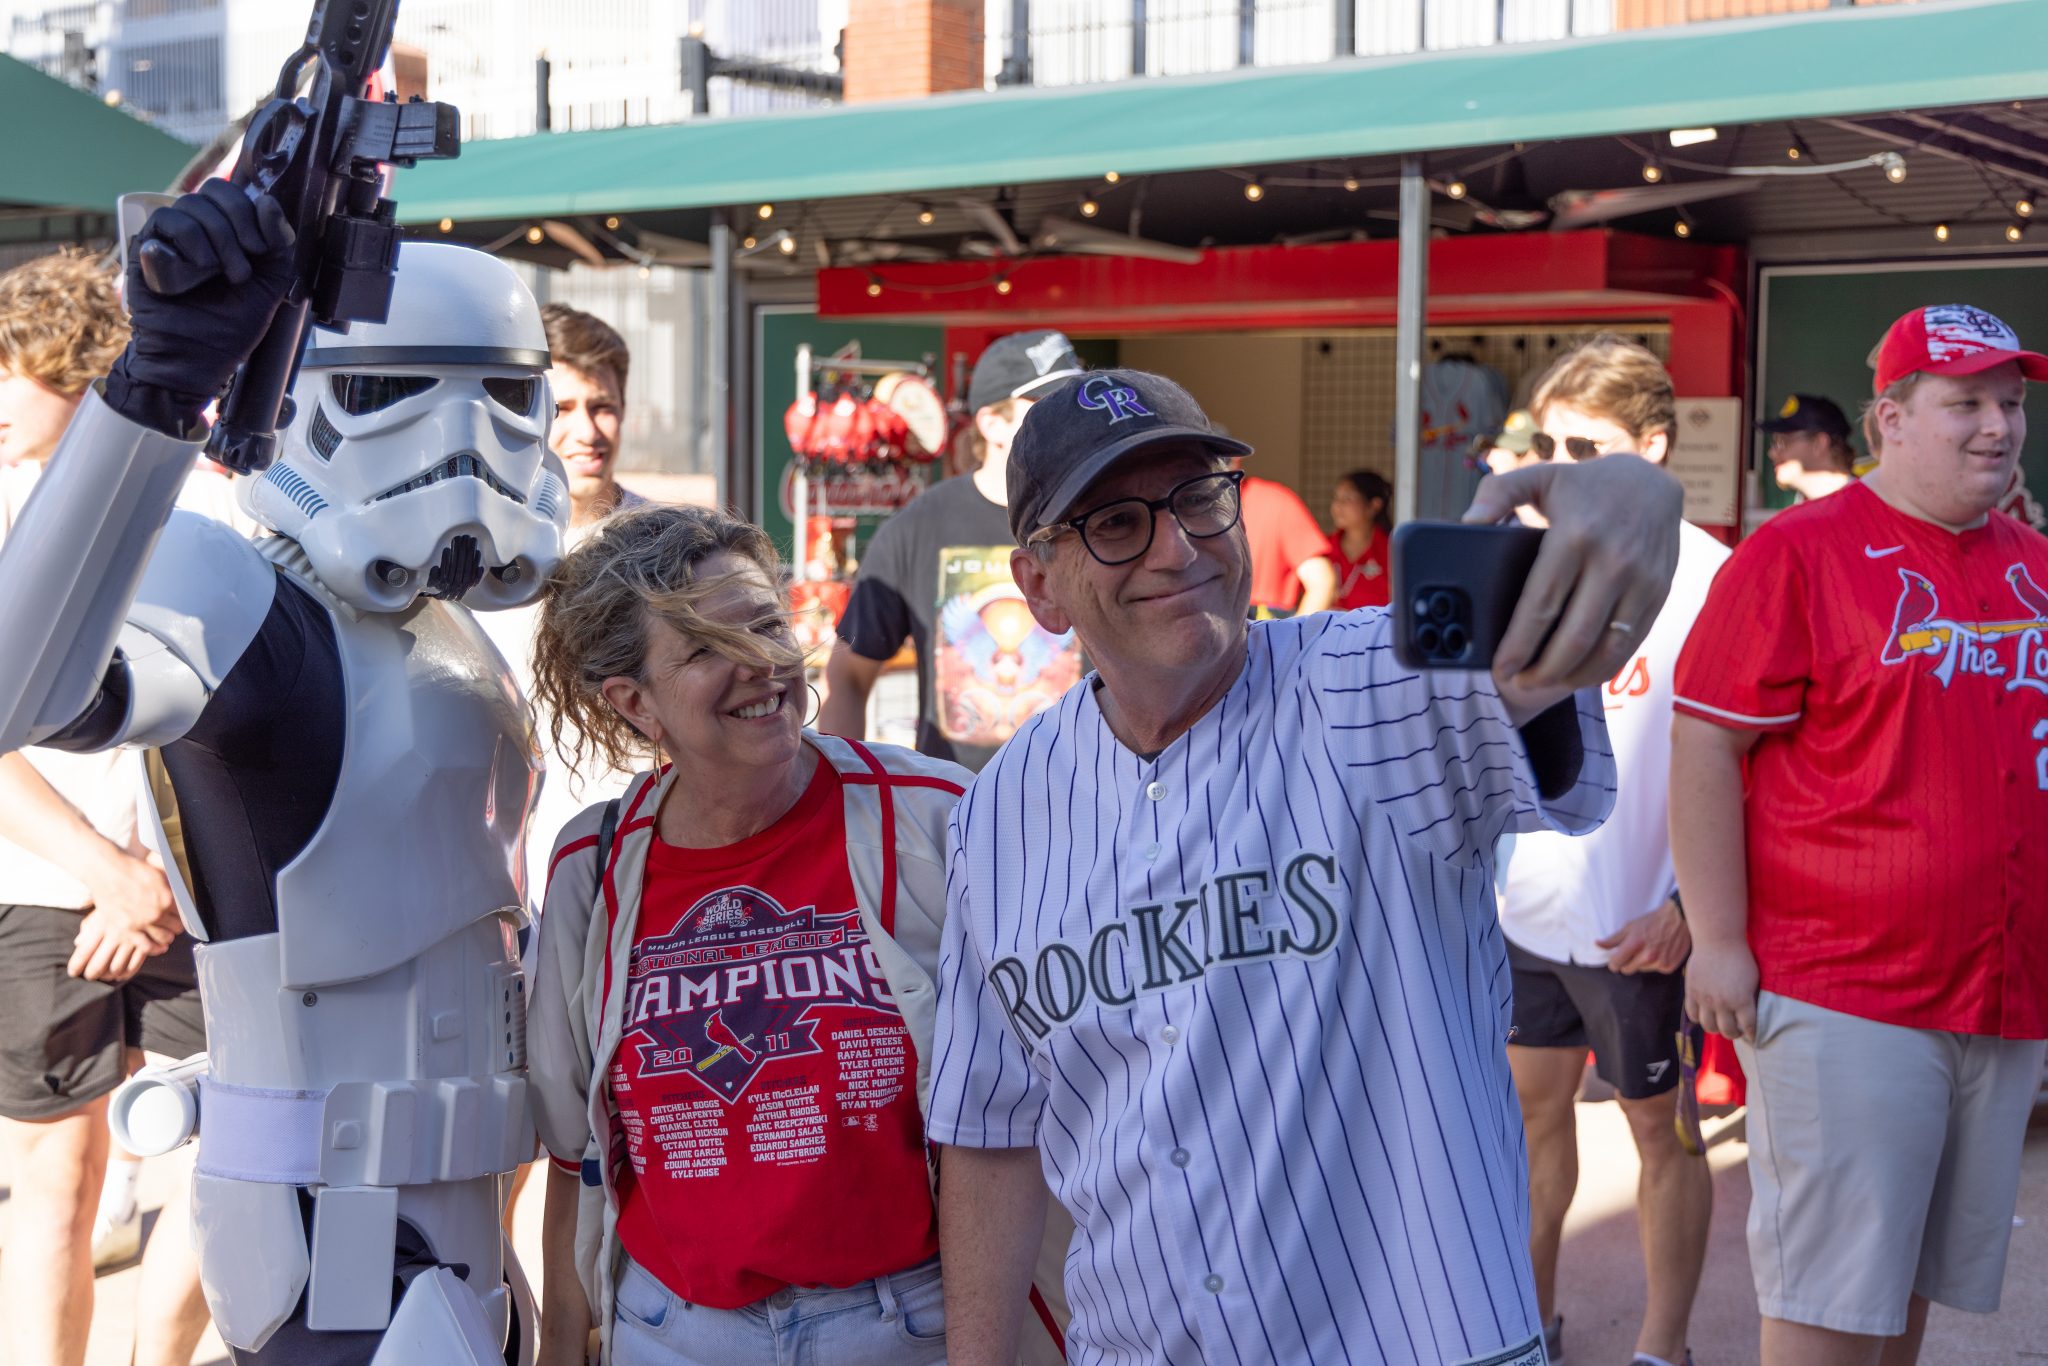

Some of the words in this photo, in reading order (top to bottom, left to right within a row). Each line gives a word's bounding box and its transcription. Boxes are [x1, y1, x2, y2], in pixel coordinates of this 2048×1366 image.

[1077, 375, 1155, 426] CR
[1920, 619, 2005, 688] The
[705, 898, 742, 916] WORLD
[702, 909, 743, 925] SERIES
[647, 940, 686, 951] MAJOR
[689, 931, 736, 944] LEAGUE
[740, 919, 803, 938] BASEBALL
[635, 951, 733, 976] NATIONAL
[741, 932, 833, 959] LEAGUE
[987, 852, 1338, 1058] ROCKIES
[831, 1029, 864, 1040] DANIEL
[653, 1047, 693, 1067] 20
[765, 1032, 790, 1051] 11
[840, 1039, 868, 1050] DAVID
[870, 1036, 903, 1047] FREESE
[837, 1049, 873, 1060] RAFAEL
[874, 1046, 906, 1057] FURCAL
[839, 1060, 870, 1070] TYLER
[871, 1056, 904, 1067] GREENE
[839, 1069, 874, 1081] ALBERT
[877, 1066, 905, 1077] PUJOLS
[848, 1080, 869, 1090] NICK
[872, 1077, 897, 1088] PUNTO
[747, 1093, 770, 1104] KYLE
[835, 1091, 857, 1101] SKIP
[858, 1085, 904, 1099] SCHUMAKER
[651, 1102, 692, 1115] MITCHELL
[692, 1099, 720, 1110] BOGGS
[755, 1101, 784, 1112] JASON
[785, 1096, 815, 1108] MOTTE
[841, 1100, 867, 1110] RYAN
[650, 1114, 674, 1125] CHRIS
[675, 1108, 725, 1120] CARPENTER
[752, 1109, 788, 1122] ARTHUR
[789, 1105, 820, 1117] RHODES
[659, 1121, 693, 1133] MAIKEL
[693, 1118, 719, 1128] CLETO
[746, 1122, 772, 1133] MARC
[774, 1114, 828, 1130] RZEPCZYNSKI
[653, 1130, 693, 1143] BRANDON
[695, 1127, 729, 1137] DICKSON
[752, 1129, 796, 1142] FERNANDO
[797, 1125, 824, 1137] SALAS
[662, 1139, 697, 1151] OCTAVIO
[698, 1137, 725, 1147] DOTEL
[750, 1140, 788, 1153] EDUARDO
[789, 1135, 826, 1148] SANCHEZ
[667, 1150, 693, 1160] JAIME
[694, 1147, 725, 1158] GARCIA
[753, 1152, 776, 1162] JAKE
[776, 1145, 827, 1160] WESTBROOK
[664, 1159, 690, 1170] EDWIN
[692, 1156, 727, 1168] JACKSON
[671, 1169, 694, 1179] KYLE
[694, 1167, 720, 1178] LOHSE
